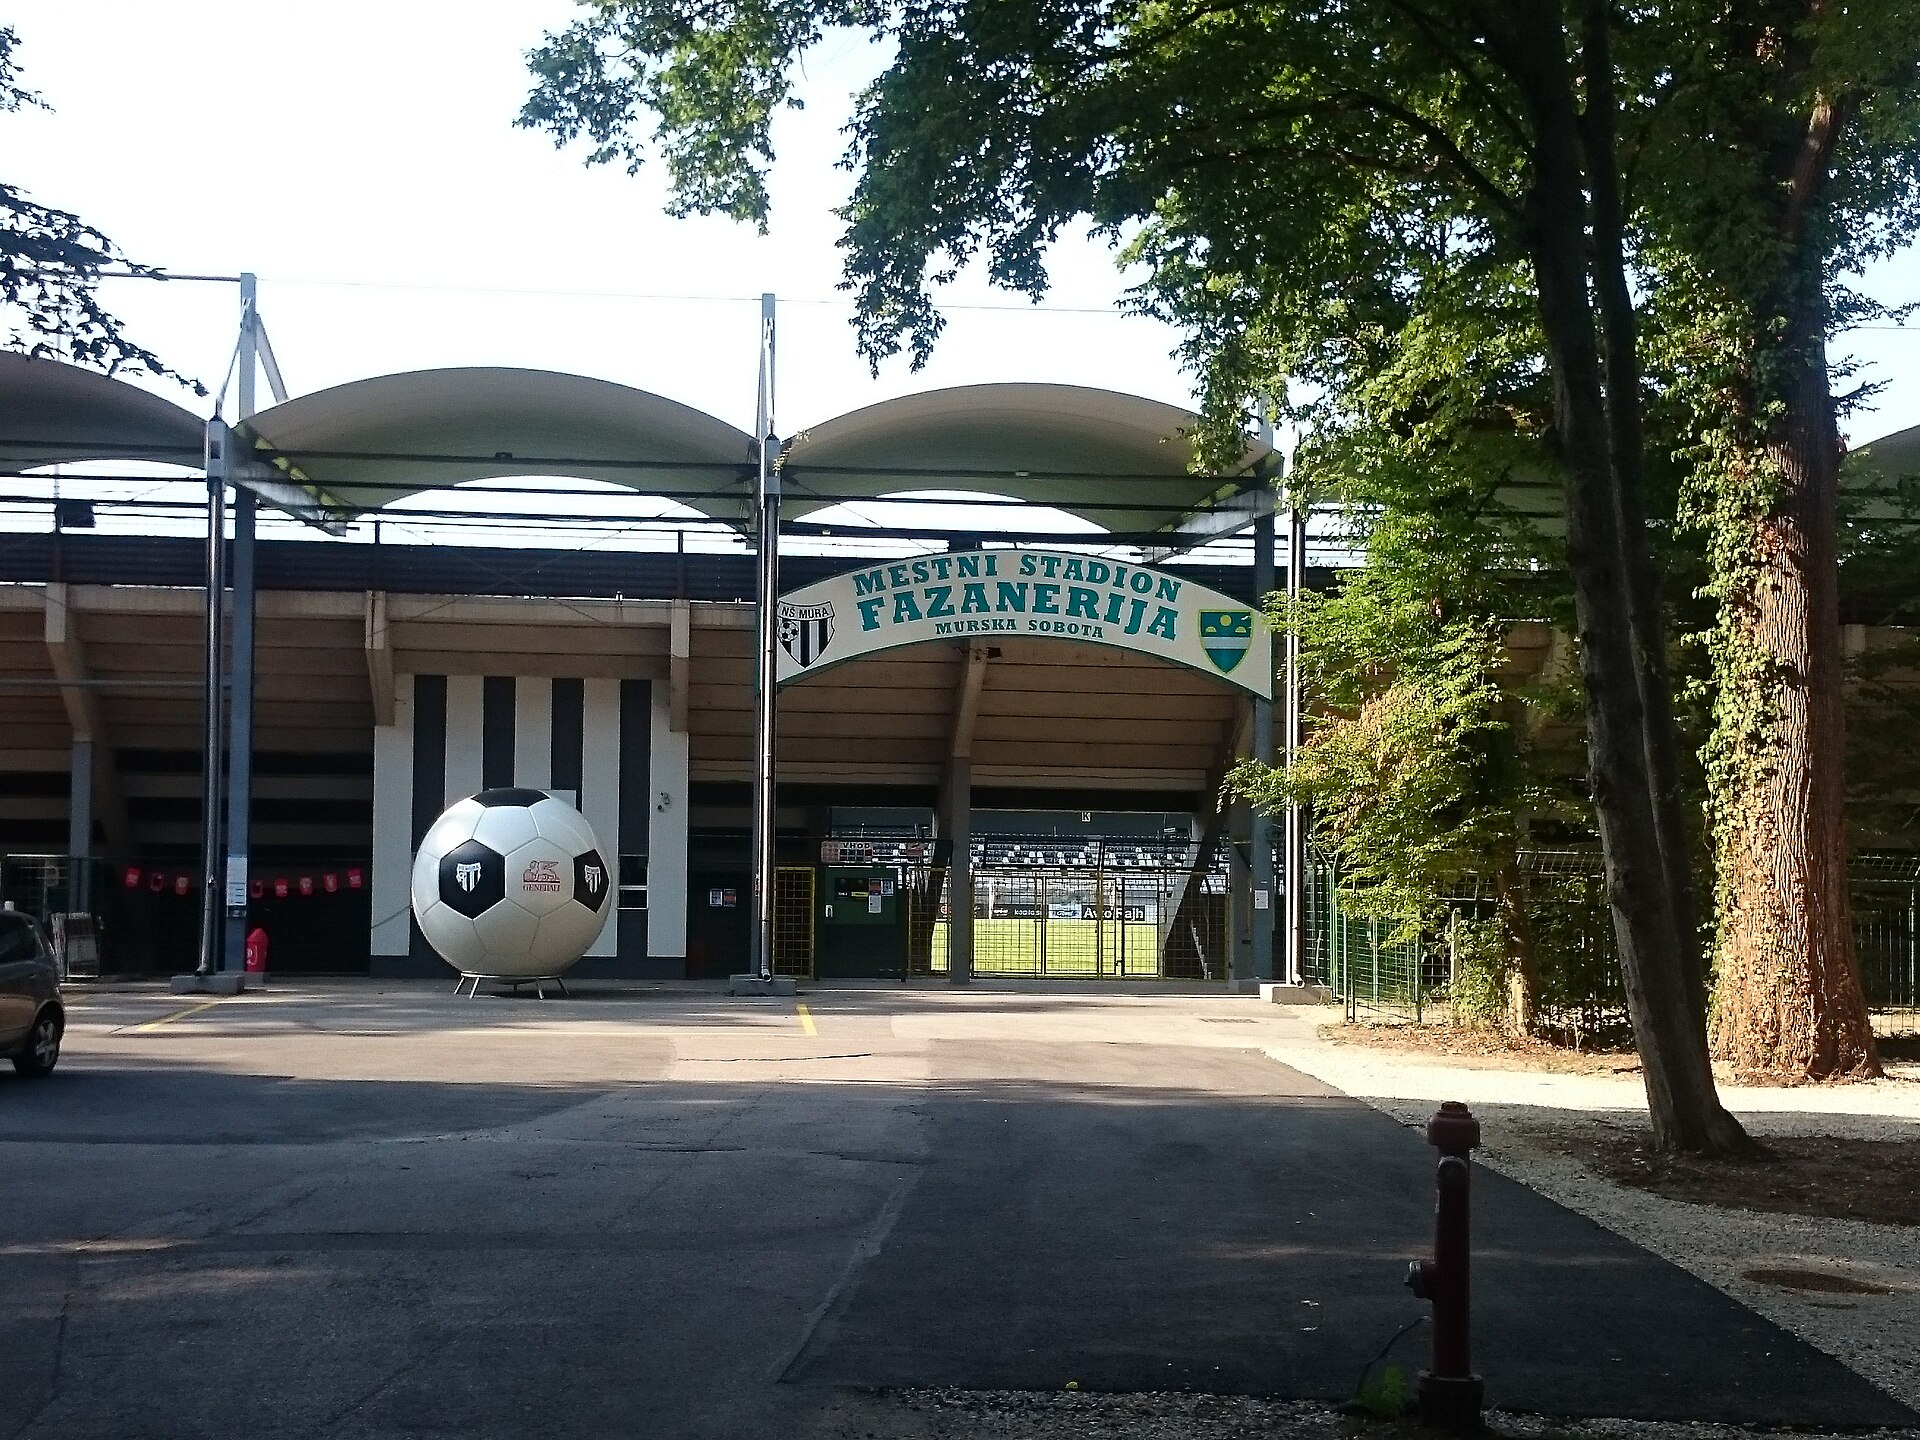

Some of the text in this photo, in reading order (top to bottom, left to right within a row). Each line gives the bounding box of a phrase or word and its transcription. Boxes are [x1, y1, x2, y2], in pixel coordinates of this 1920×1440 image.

[852, 554, 1182, 603] MESTNI STADION
[799, 607, 830, 619] MURA
[856, 581, 1179, 642] FAZANERIJA
[935, 618, 1104, 639] MURSKA SOBOTA
[1083, 907, 1112, 919] Avo
